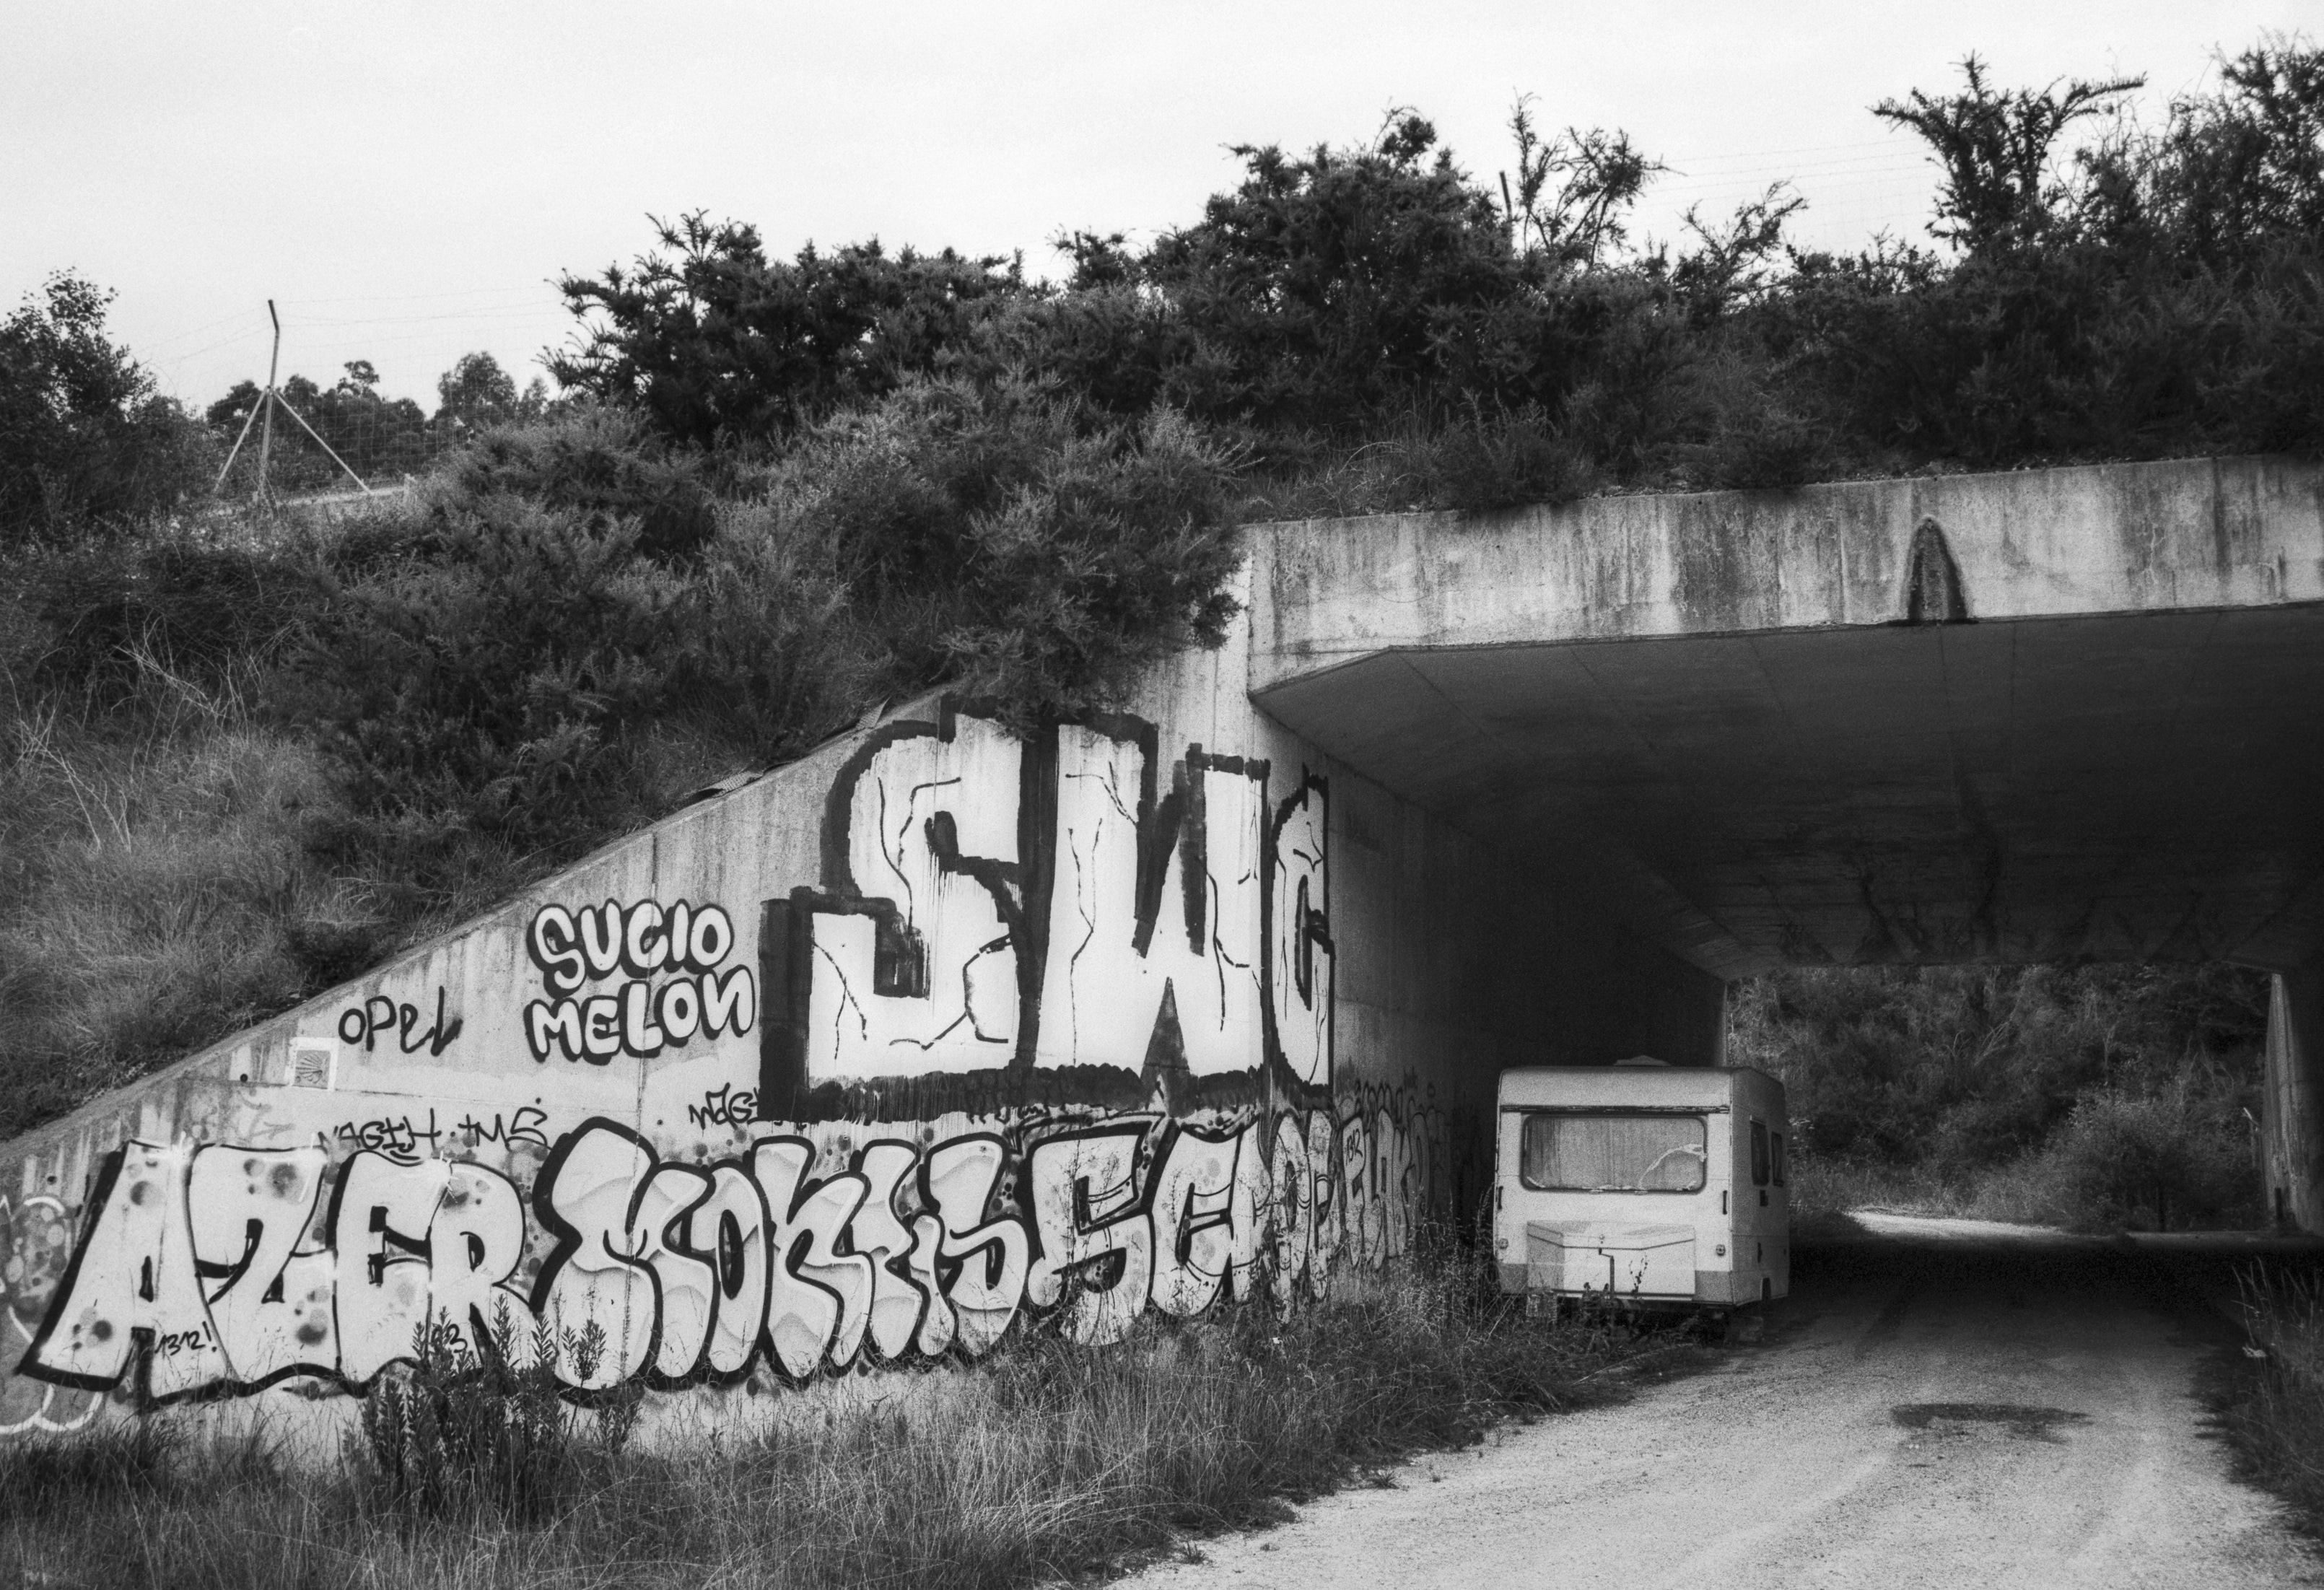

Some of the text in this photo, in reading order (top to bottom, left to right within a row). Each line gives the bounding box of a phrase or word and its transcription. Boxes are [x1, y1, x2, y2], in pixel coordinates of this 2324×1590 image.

[526, 899, 734, 998] SUCIO
[523, 965, 755, 1065] MELON
[18, 1138, 538, 1413] AZER
